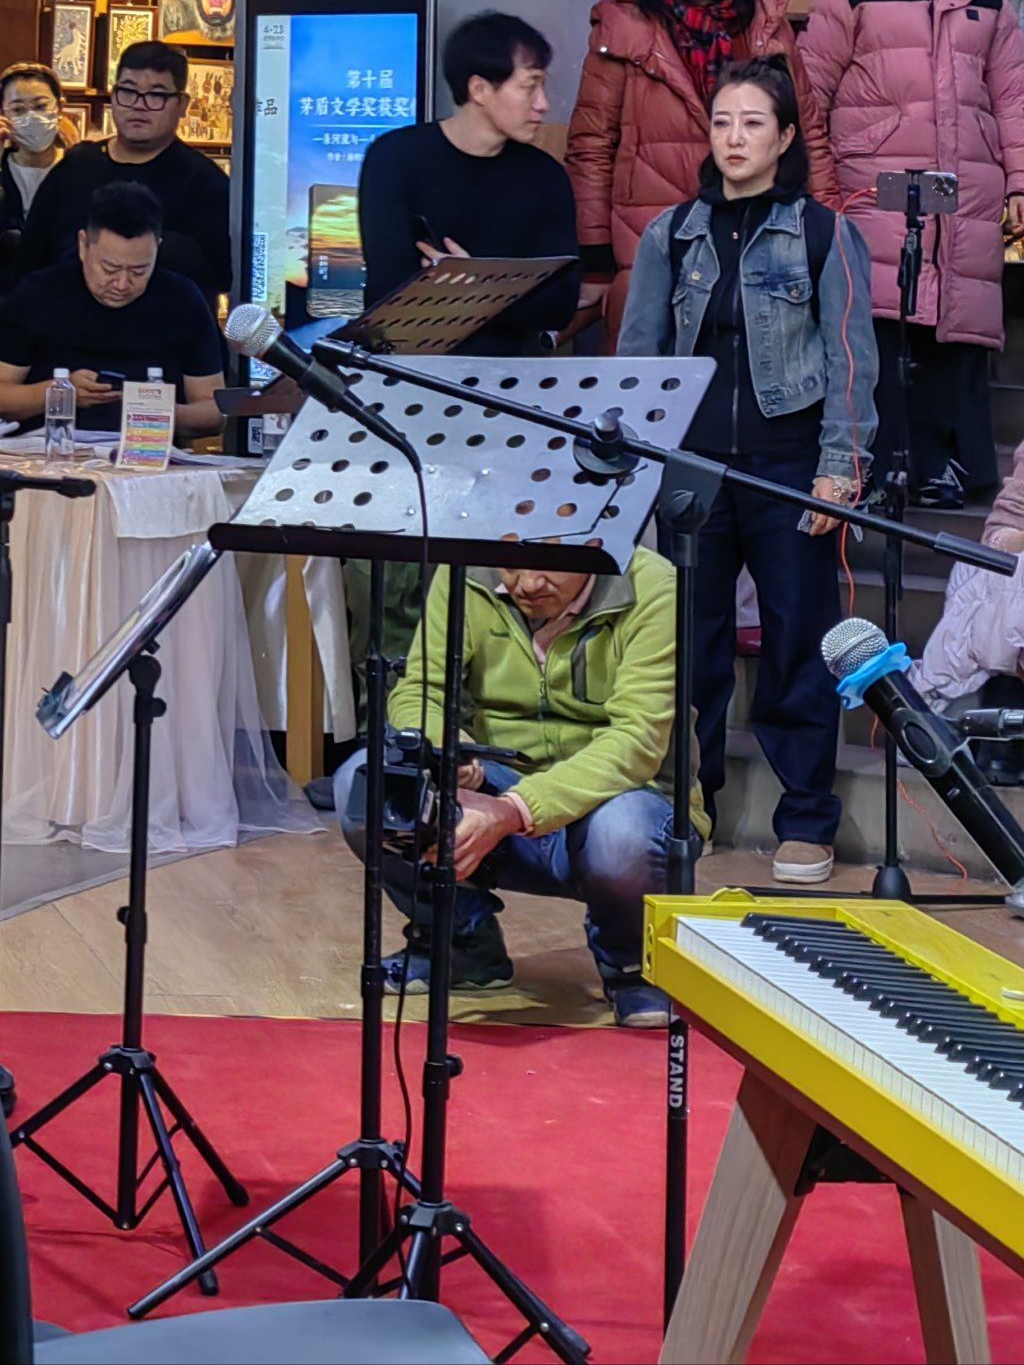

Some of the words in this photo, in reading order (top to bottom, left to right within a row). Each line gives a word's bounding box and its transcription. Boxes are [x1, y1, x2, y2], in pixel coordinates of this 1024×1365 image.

[347, 69, 394, 89] 第十届
[669, 1034, 685, 1109] STAND
